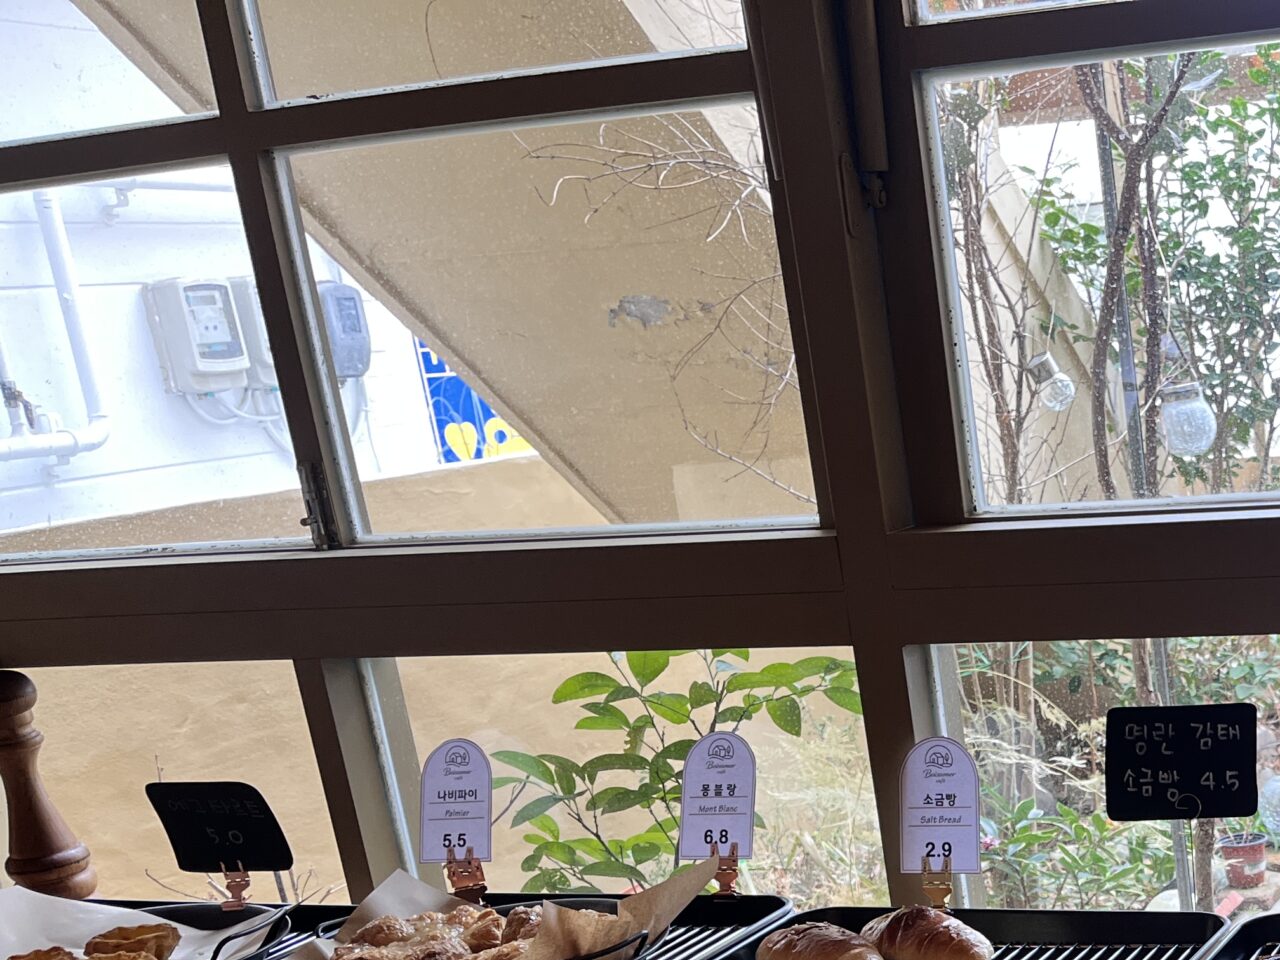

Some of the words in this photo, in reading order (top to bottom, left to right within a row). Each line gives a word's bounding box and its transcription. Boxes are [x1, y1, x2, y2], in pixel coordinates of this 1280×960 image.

[1124, 722, 1175, 755] 명란
[1190, 722, 1240, 750] 감태
[1200, 770, 1239, 791] 4.5
[437, 789, 478, 801] 나비파이
[923, 793, 957, 807] 소금빵
[445, 809, 470, 817] Palmier
[920, 816, 938, 824] Salt
[206, 827, 243, 845] 5.0
[442, 833, 467, 848] 5.5
[704, 829, 729, 844] 6.8
[925, 842, 952, 858] 2.9
